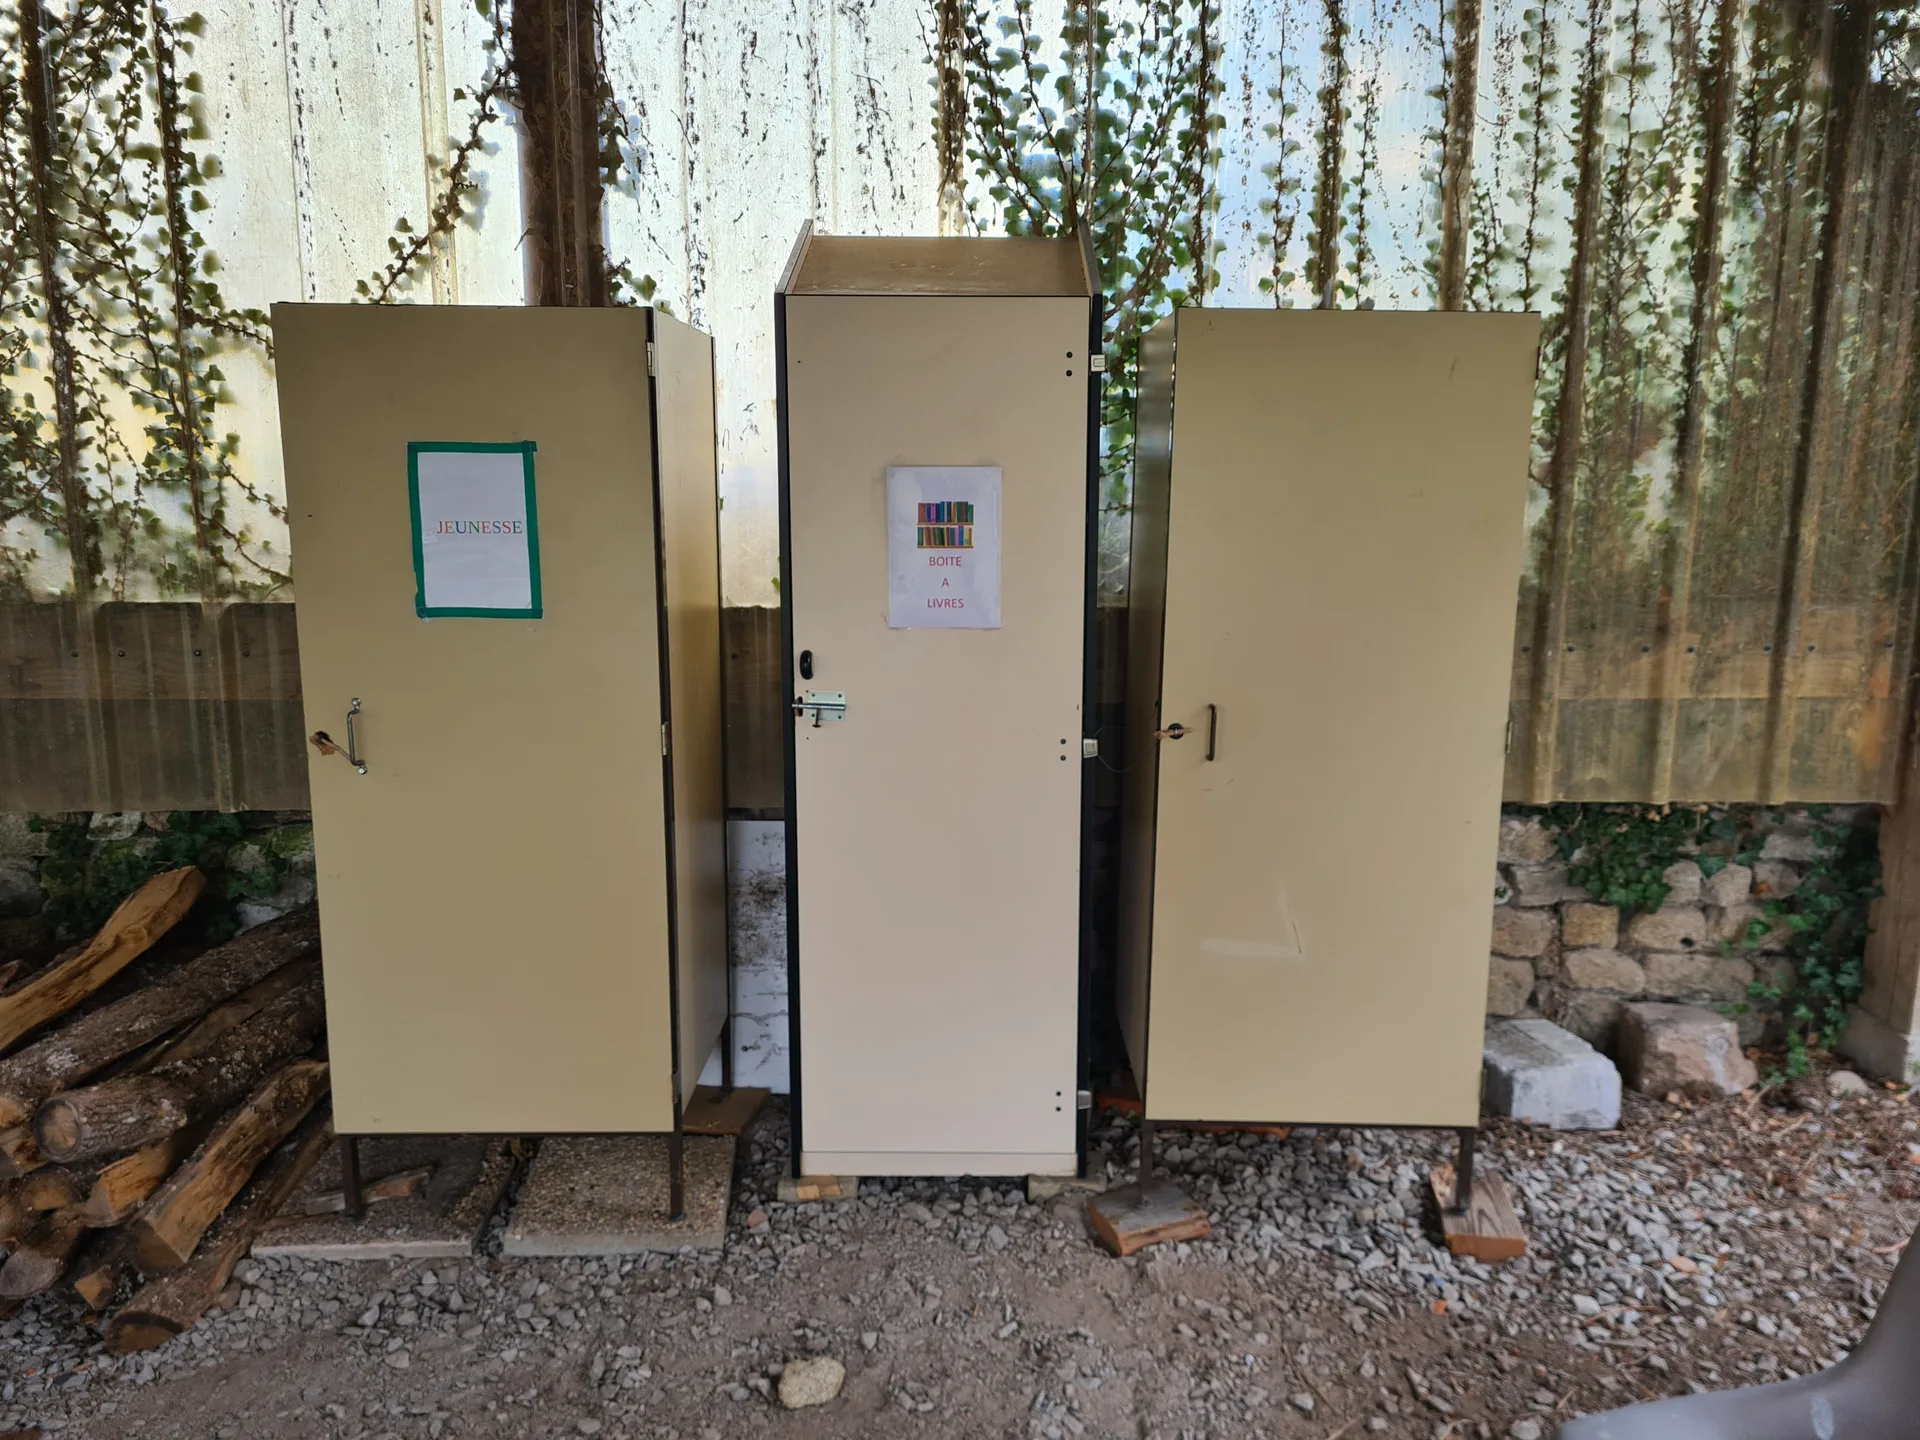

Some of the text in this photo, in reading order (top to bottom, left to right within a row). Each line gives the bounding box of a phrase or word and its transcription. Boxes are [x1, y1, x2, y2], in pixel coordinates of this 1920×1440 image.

[436, 520, 523, 534] JEUNESSE
[928, 556, 962, 567] BOITE
[941, 577, 950, 588] A
[927, 598, 965, 609] LIVRES
